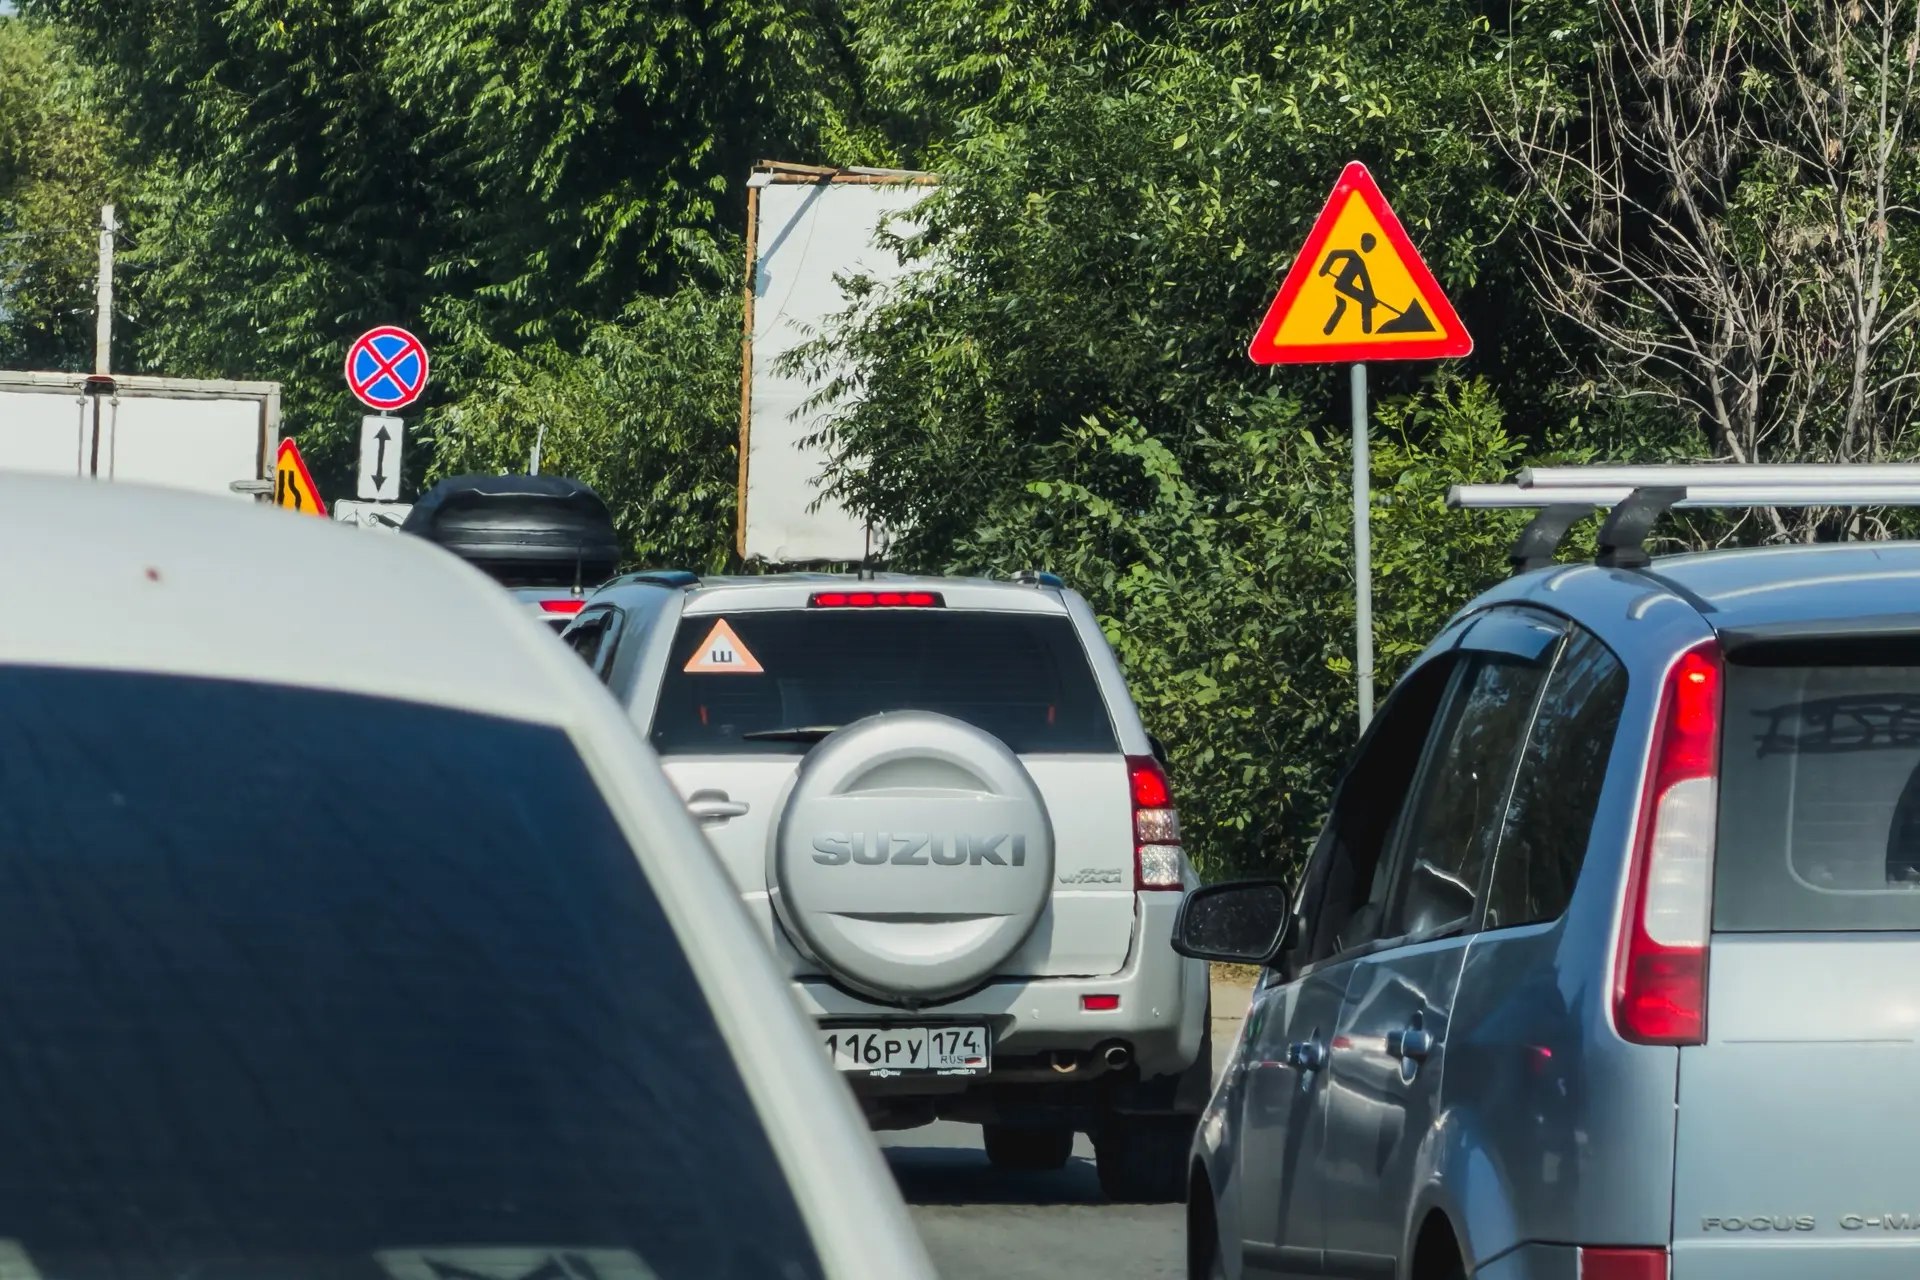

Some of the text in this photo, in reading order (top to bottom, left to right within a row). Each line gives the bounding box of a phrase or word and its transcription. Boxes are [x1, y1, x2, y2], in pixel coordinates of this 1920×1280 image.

[711, 650, 732, 663] Ш
[812, 832, 1026, 867] SUZUKI
[932, 1031, 976, 1055] 174
[941, 1055, 963, 1064] RUS
[1702, 1215, 1815, 1232] FOCUS
